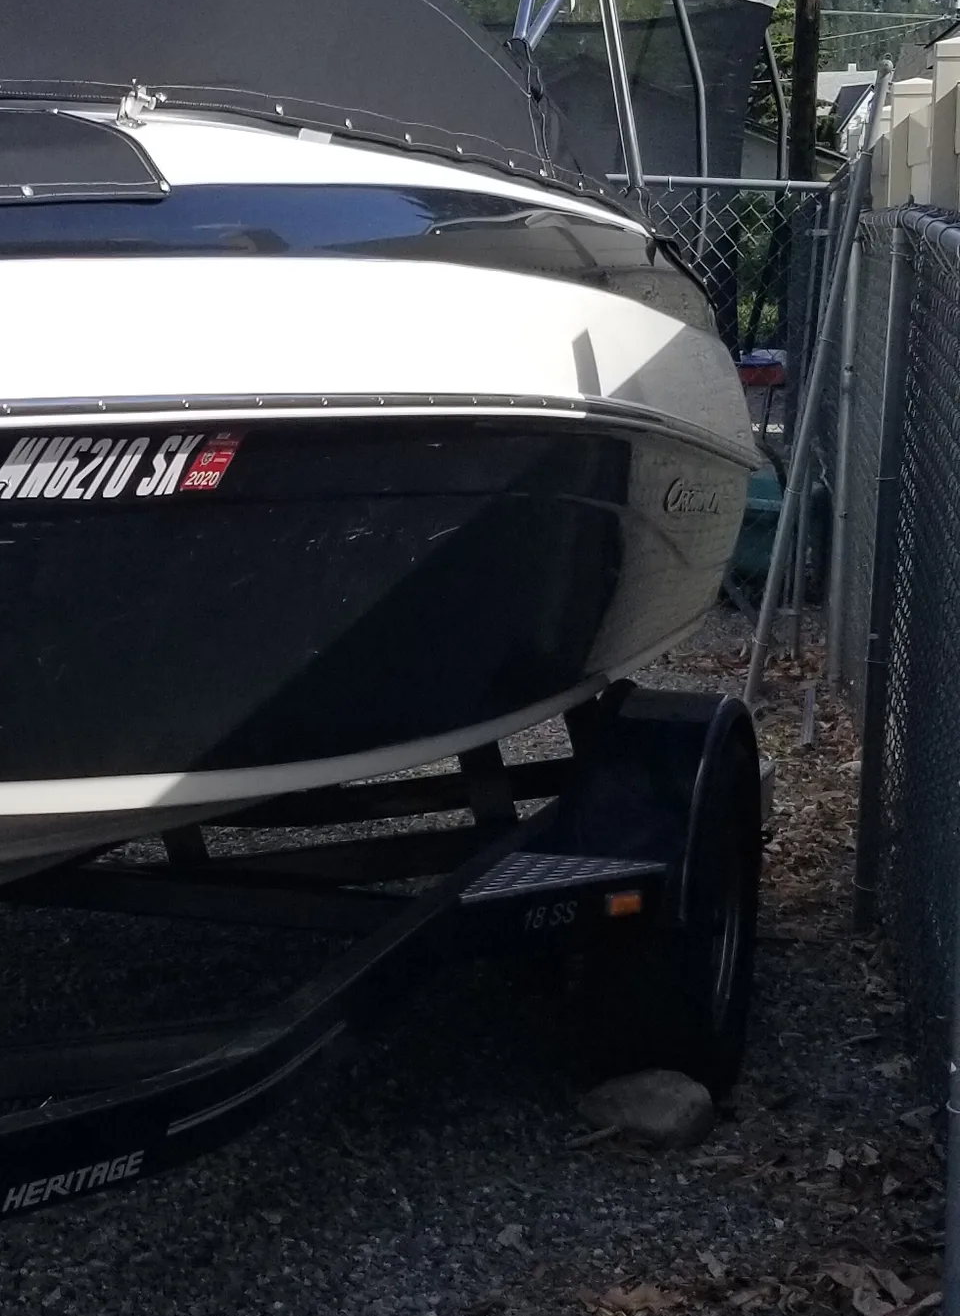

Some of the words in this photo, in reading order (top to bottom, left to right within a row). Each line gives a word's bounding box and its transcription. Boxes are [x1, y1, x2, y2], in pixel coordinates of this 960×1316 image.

[135, 434, 205, 497] SK
[184, 470, 220, 487] 2020
[524, 906, 548, 931] 18
[549, 900, 578, 927] SS
[2, 1150, 145, 1213] HERITAGE
